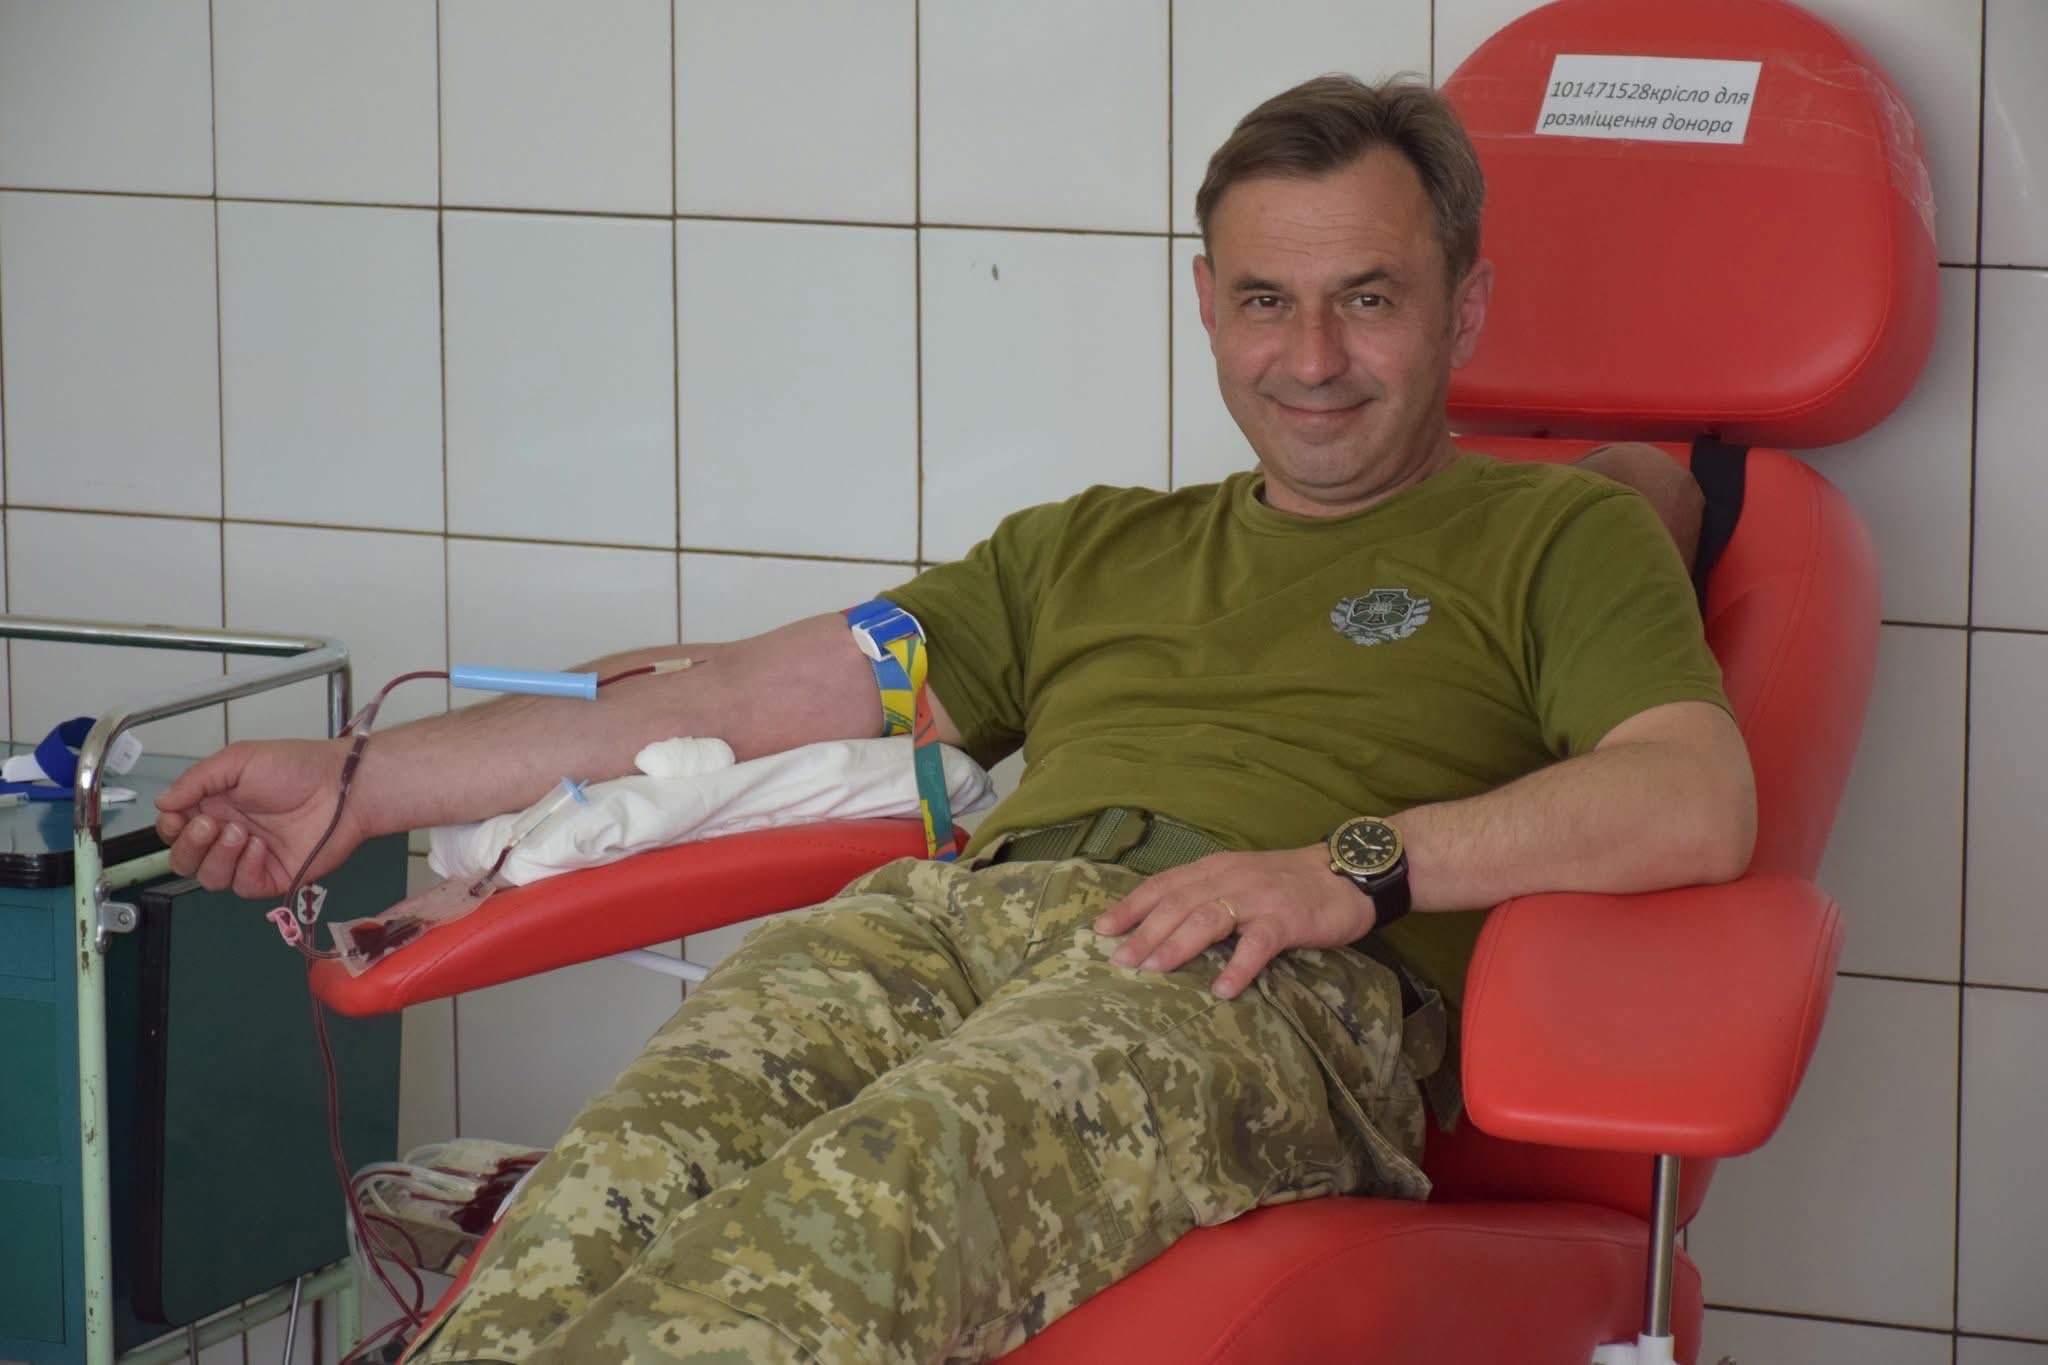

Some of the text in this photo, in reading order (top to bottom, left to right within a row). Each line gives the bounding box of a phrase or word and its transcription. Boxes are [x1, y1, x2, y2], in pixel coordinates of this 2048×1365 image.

[1714, 87, 1750, 105] для
[1542, 111, 1733, 135] розміщення донора
